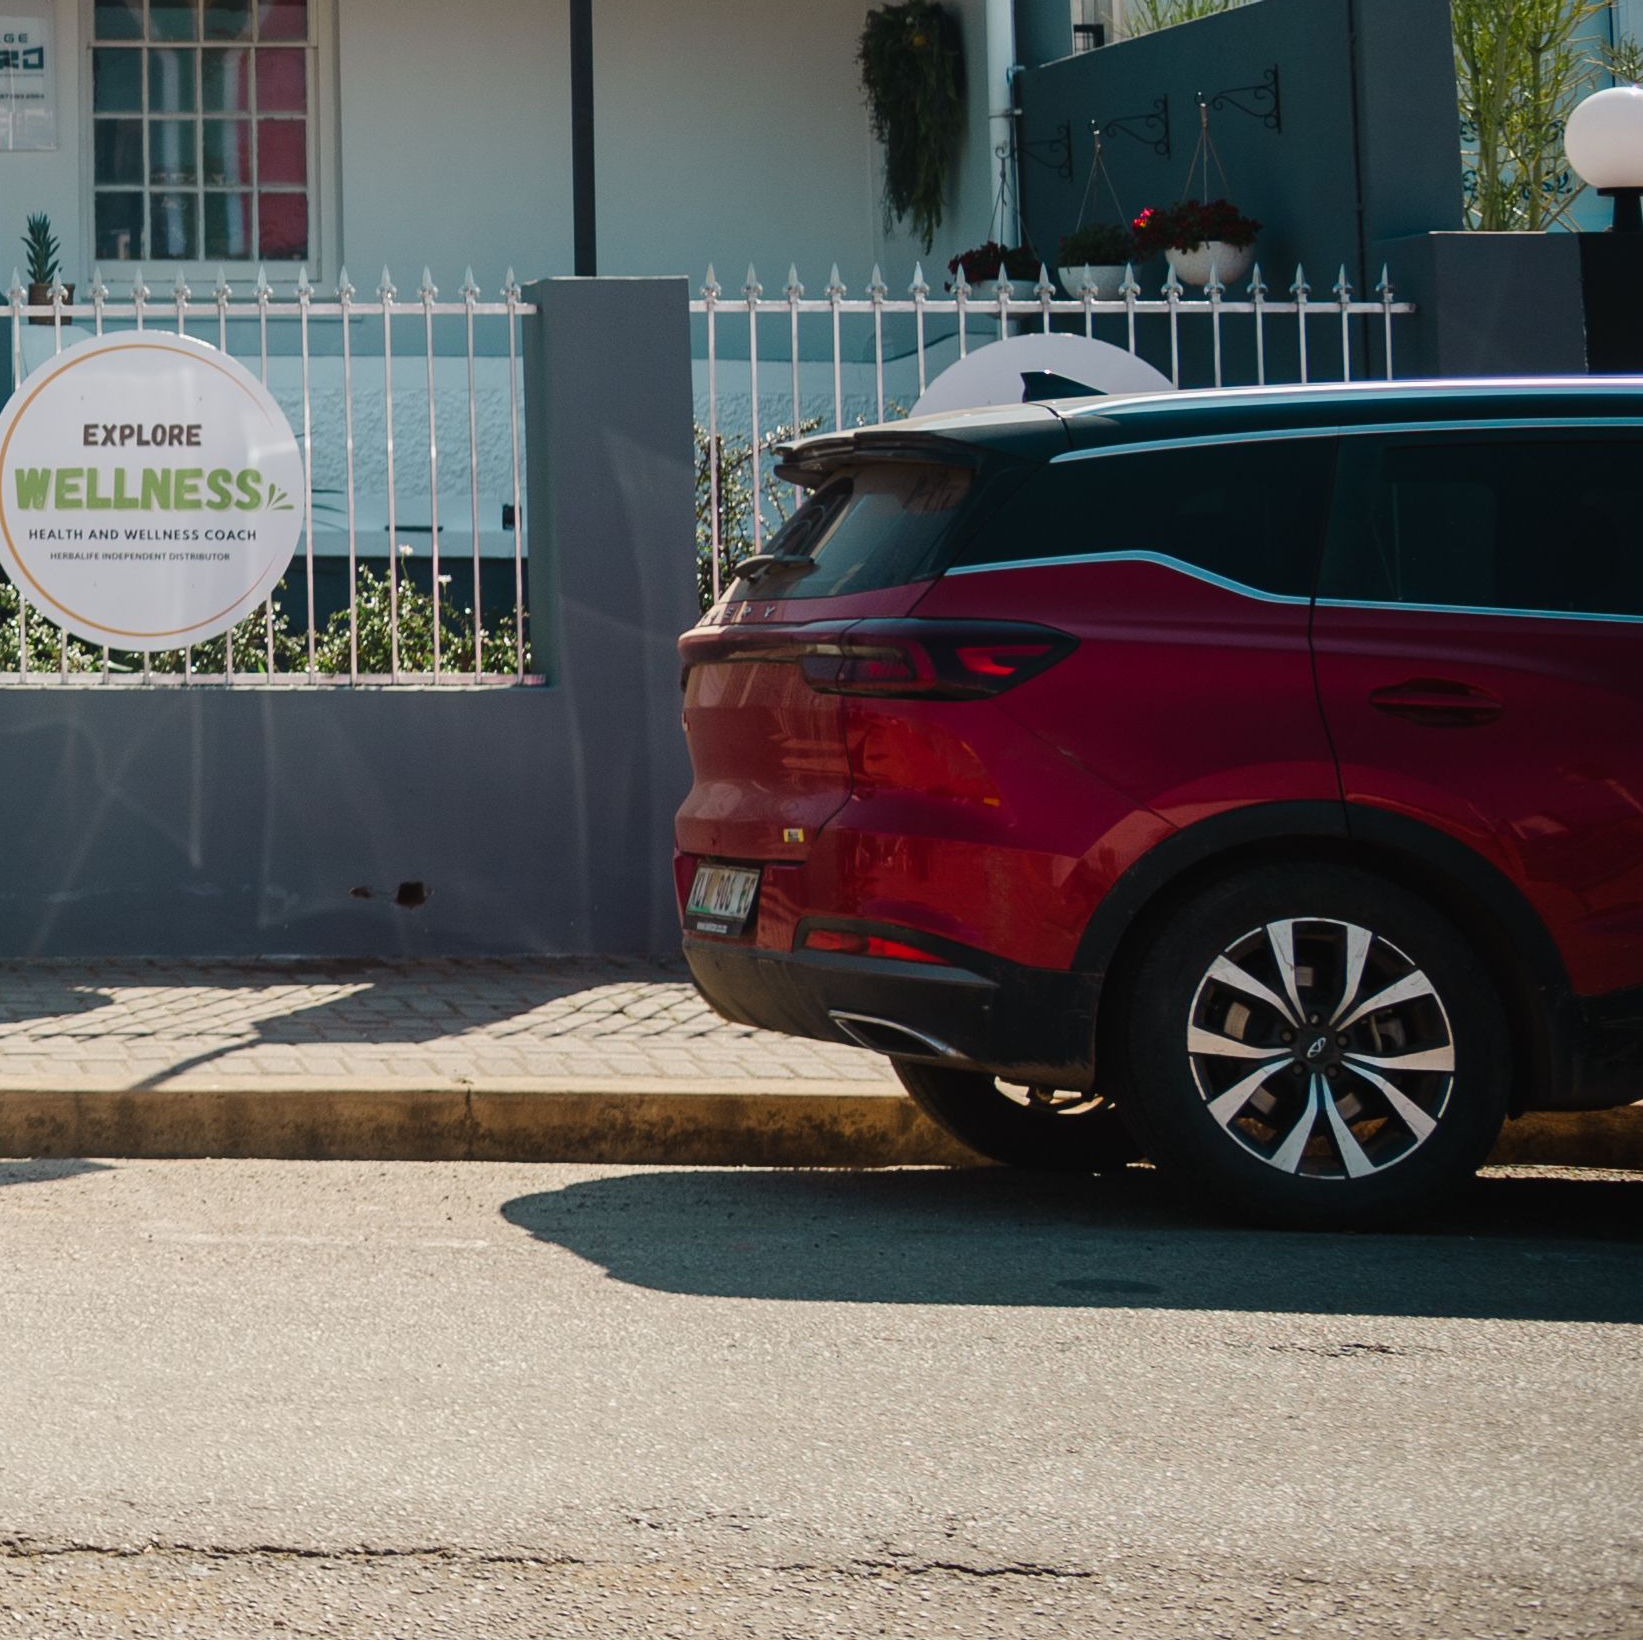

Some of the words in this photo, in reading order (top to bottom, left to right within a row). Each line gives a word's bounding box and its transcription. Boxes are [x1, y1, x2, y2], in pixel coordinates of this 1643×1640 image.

[82, 423, 203, 447] EXPLORE
[14, 467, 264, 512] WELLNESS
[29, 529, 83, 540] HEALTH
[88, 529, 119, 540] AND
[124, 529, 199, 540] WELLNESS
[204, 529, 257, 540] COACH
[50, 552, 99, 561] HERBALIFE
[102, 552, 166, 561] INDEPENDENT
[169, 552, 230, 561] DISTRIBUTOR
